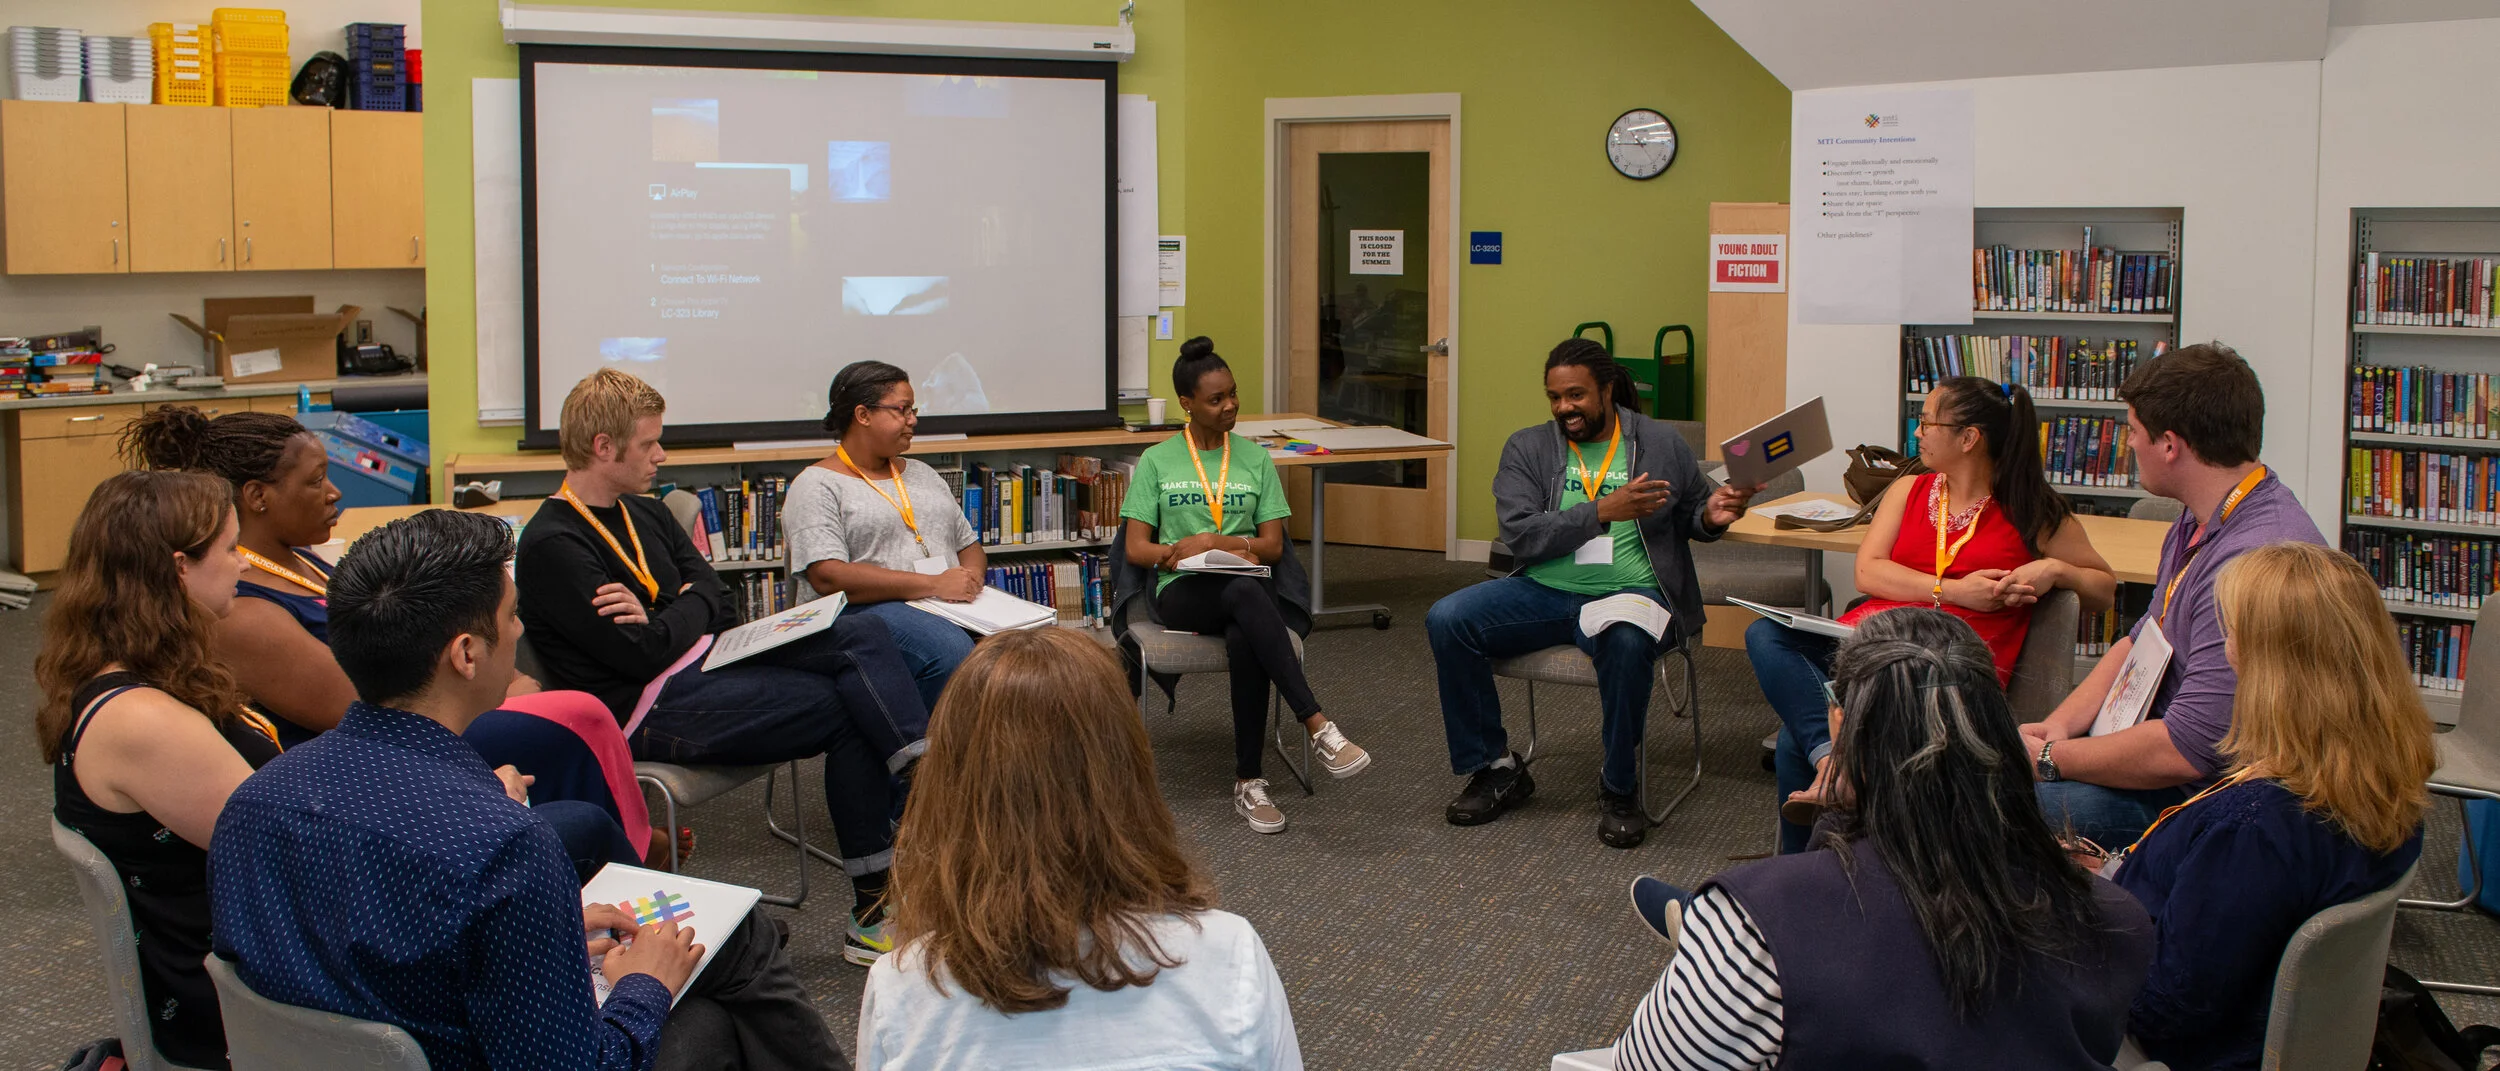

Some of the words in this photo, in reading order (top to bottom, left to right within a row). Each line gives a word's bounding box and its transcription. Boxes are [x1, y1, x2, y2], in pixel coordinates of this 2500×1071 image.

[1639, 112, 1645, 120] 12
[1836, 137, 1878, 145] Community
[670, 188, 698, 200] AirPlay
[1885, 210, 1920, 218] perspective
[1719, 243, 1748, 255] YOUNG
[1751, 243, 1778, 255] ADULT
[651, 264, 655, 272] 1
[1728, 264, 1767, 277] FICTION
[660, 274, 693, 284] Connect
[696, 274, 706, 284] To
[707, 274, 728, 284] Wi-Fi
[729, 274, 761, 284] Network
[650, 297, 656, 307] 2
[692, 308, 719, 319] Library
[1161, 481, 1188, 490] MAKE
[1168, 493, 1246, 507] EXPLCIT
[244, 552, 301, 581] MULTICULTURAL
